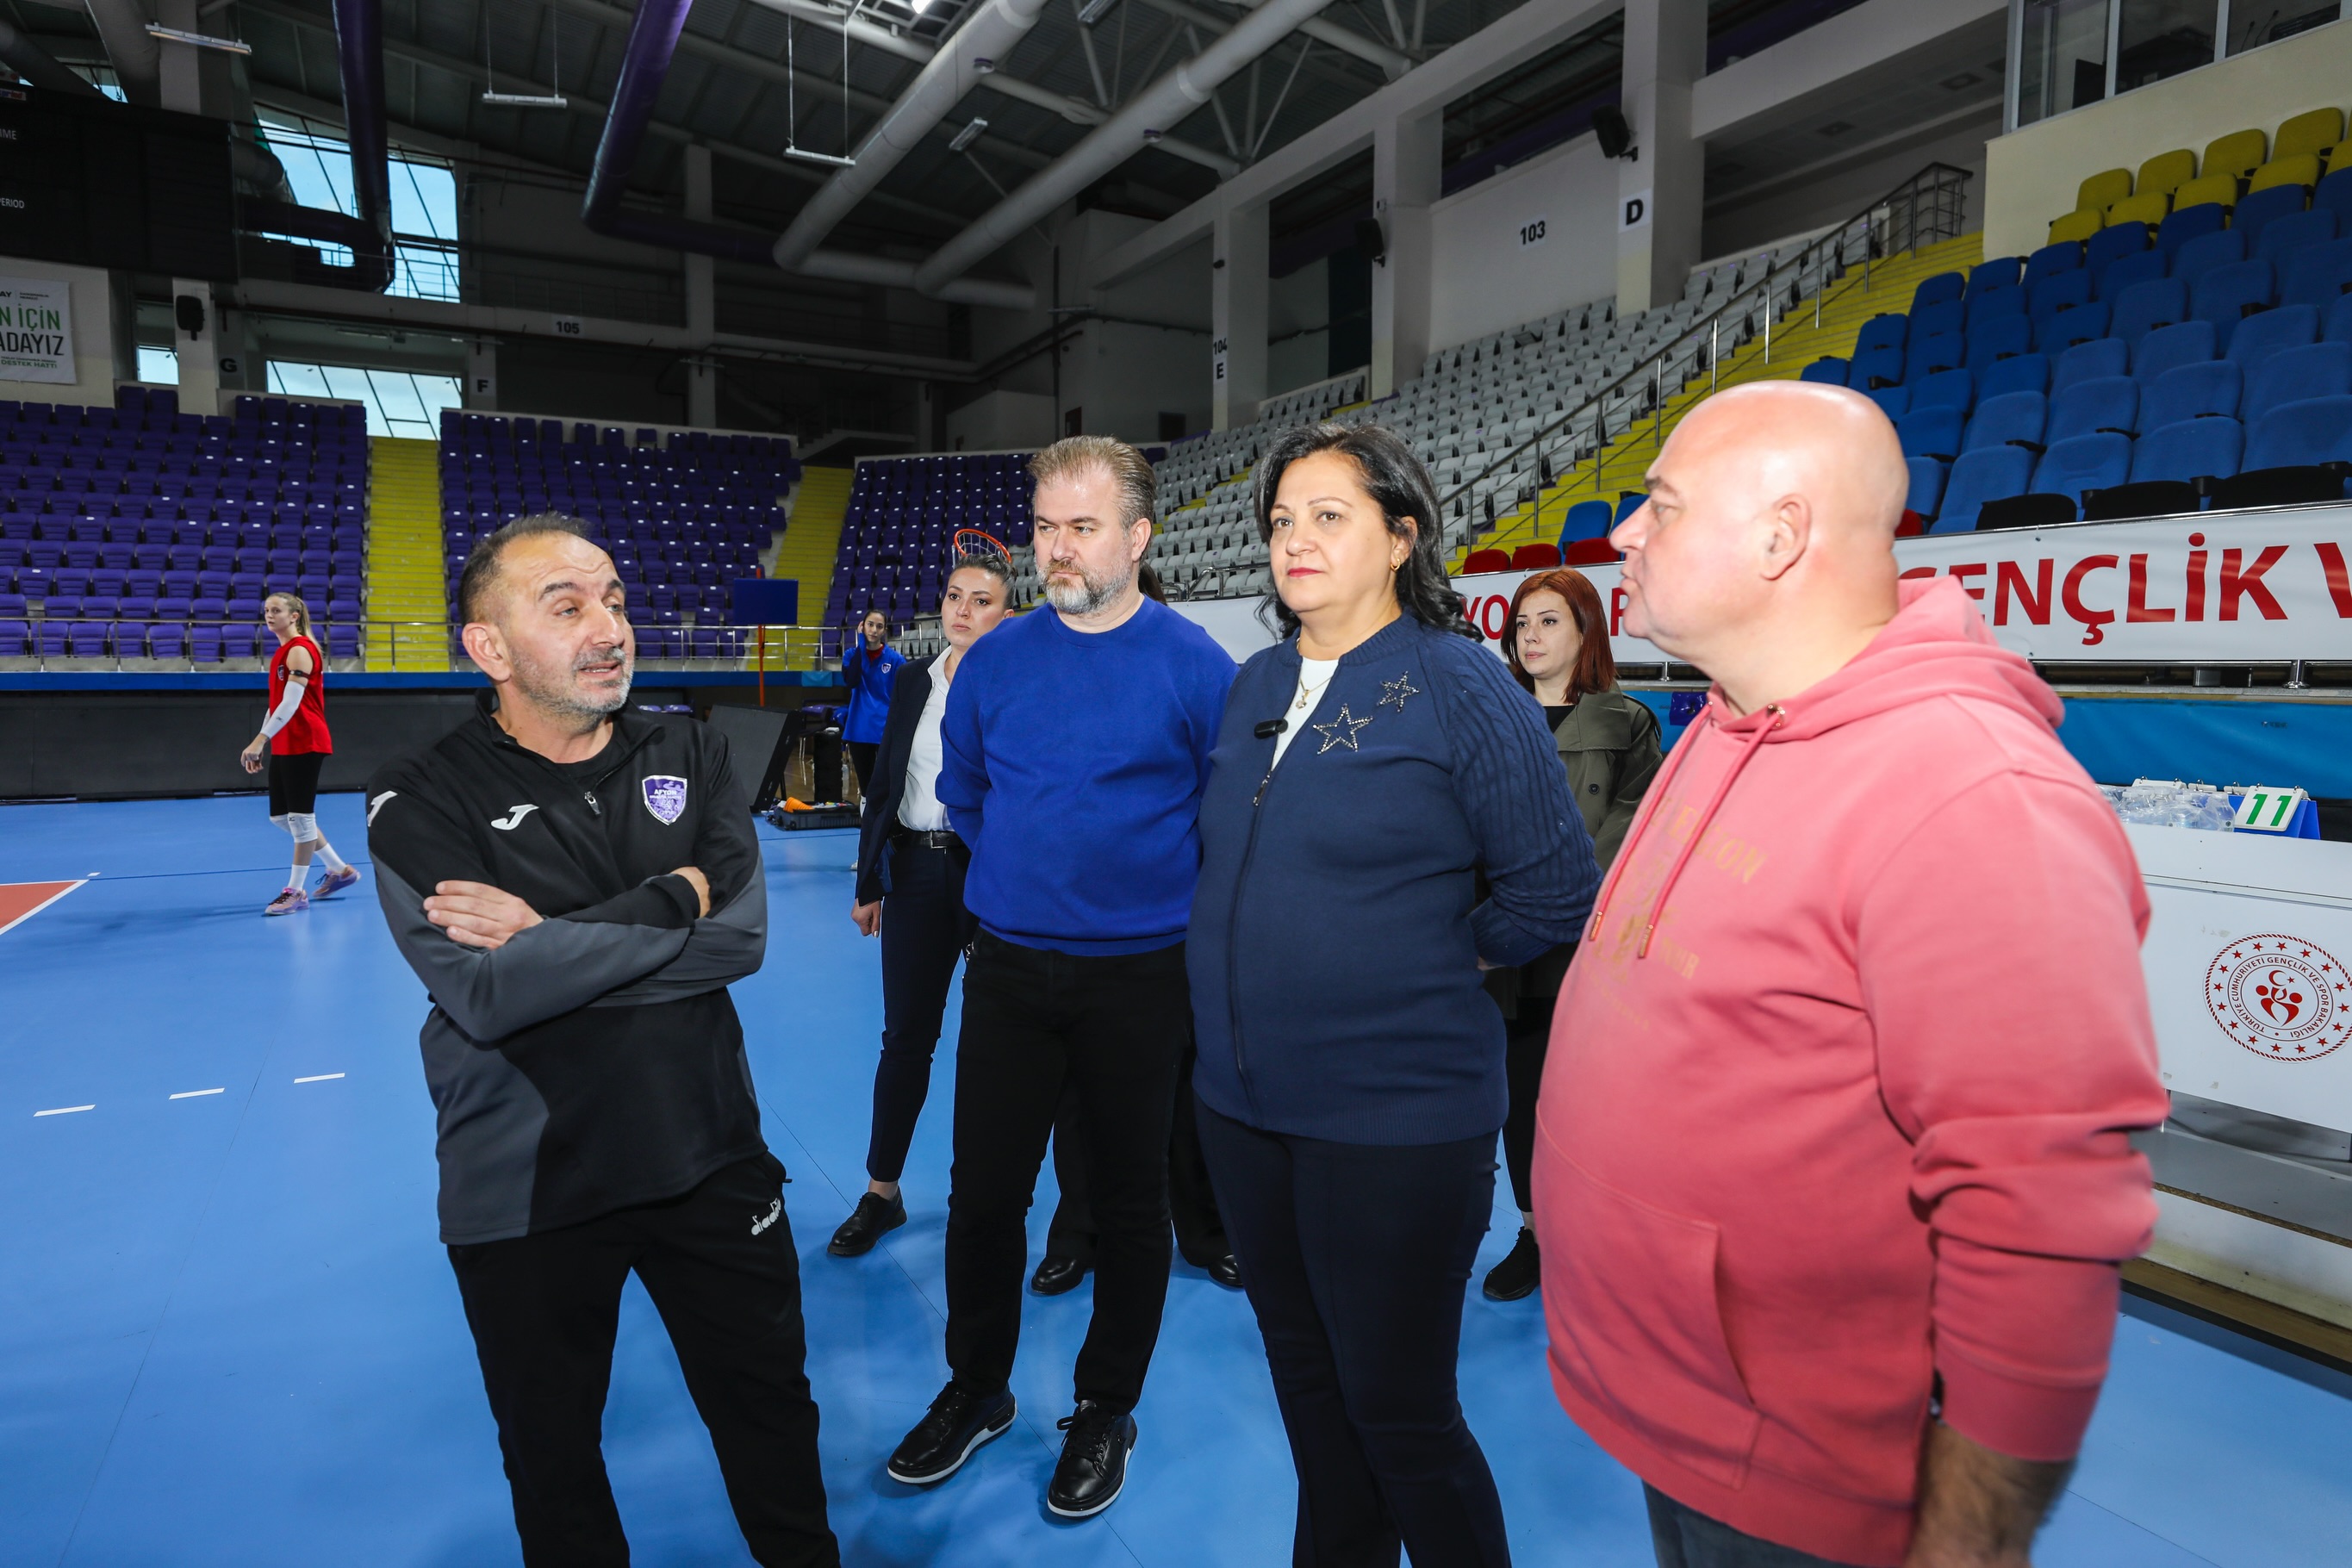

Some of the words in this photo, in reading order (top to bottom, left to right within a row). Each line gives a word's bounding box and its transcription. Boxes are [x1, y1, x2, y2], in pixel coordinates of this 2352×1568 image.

[1626, 199, 1644, 226] D
[1520, 220, 1546, 245] 103
[18, 303, 61, 331] İÇİN
[556, 321, 580, 334] 105
[1213, 337, 1228, 355] 104
[219, 358, 238, 373] G
[1216, 362, 1224, 379] E
[476, 379, 488, 393] F
[1898, 532, 2291, 646] ENÇLİK
[2245, 793, 2293, 827] 11
[2267, 956, 2309, 974] GENÇLİK
[2308, 971, 2321, 983] VE
[2231, 956, 2265, 1002] CUMHURİYETİ
[2316, 983, 2329, 1005] SPOR
[2235, 1003, 2265, 1033] TÜRKİYE
[2290, 1008, 2329, 1039] BAKANLIĞI
[750, 1197, 781, 1235] diado
